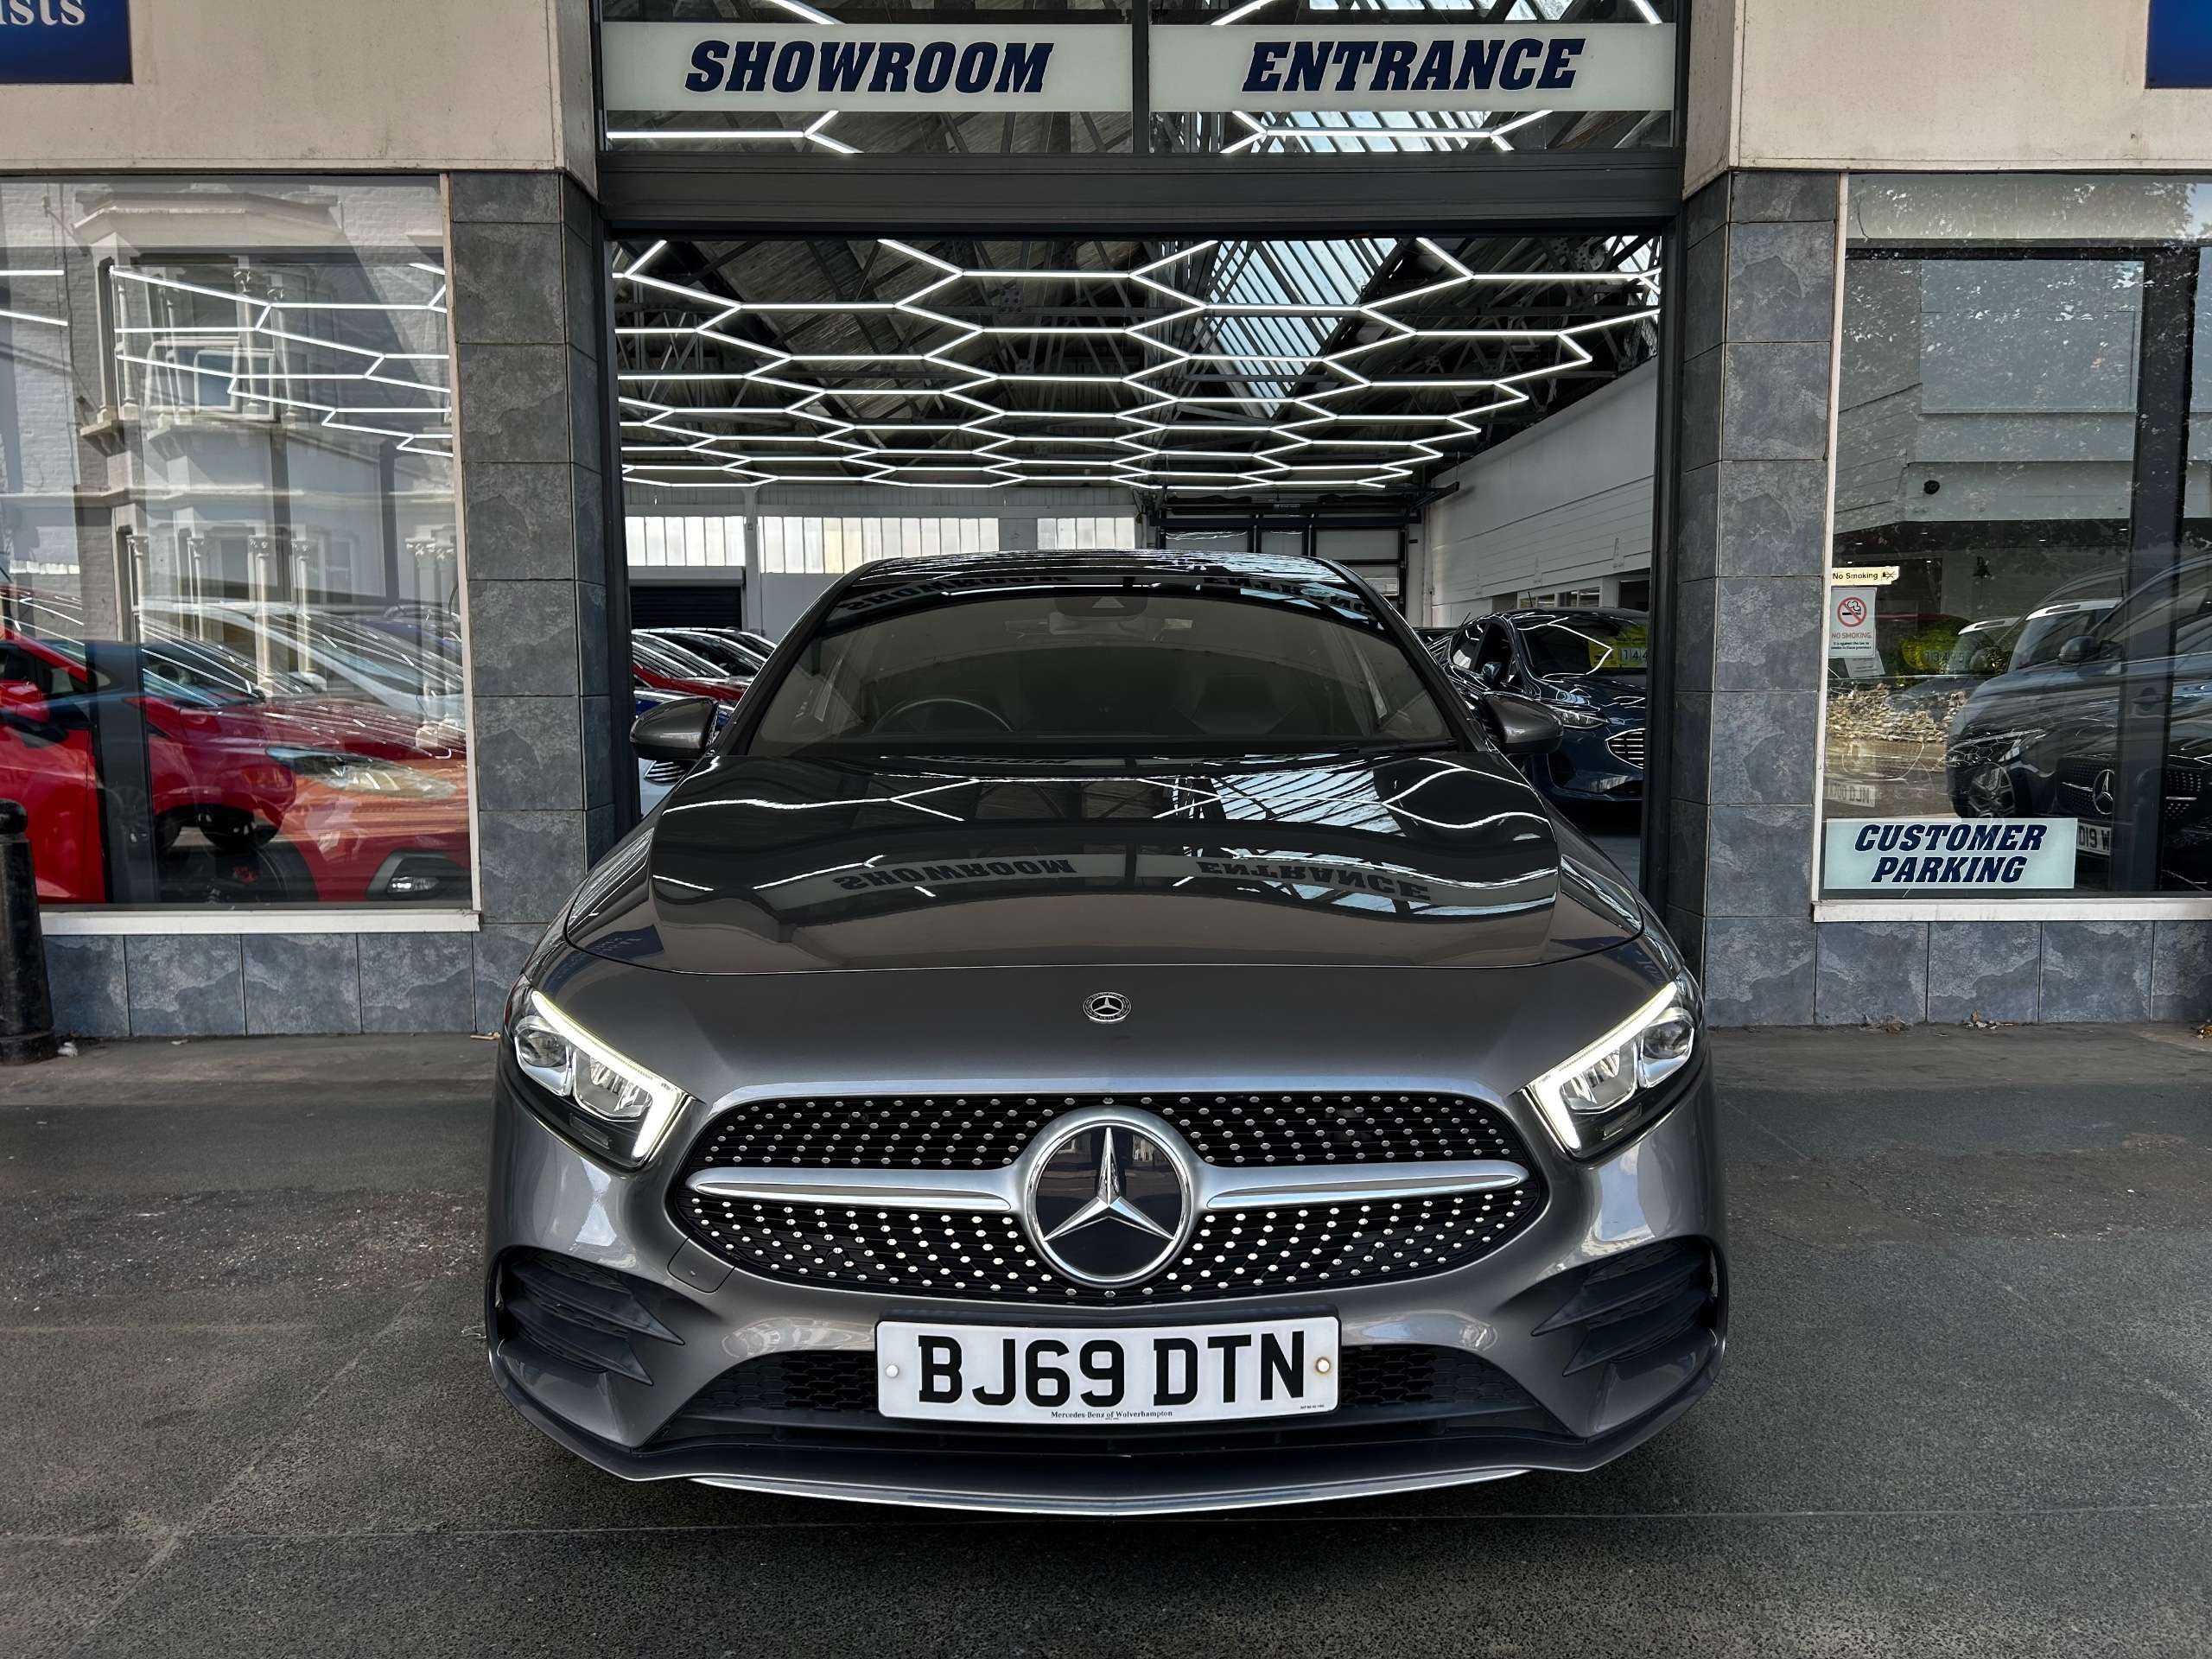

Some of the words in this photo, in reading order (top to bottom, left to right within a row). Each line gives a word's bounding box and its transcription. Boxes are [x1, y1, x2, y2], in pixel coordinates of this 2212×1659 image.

[0, 0, 85, 26] sts
[685, 40, 1055, 93] SHOWROOM
[1242, 38, 1586, 92] ENTRANCE
[1854, 823, 2048, 851] CUSTOMER
[1871, 855, 2028, 882] PARKING
[918, 1335, 1124, 1407] BJ69
[1154, 1331, 1304, 1407] DTN
[1106, 1410, 1115, 1419] of
[1116, 1410, 1173, 1419] Wolverhampton
